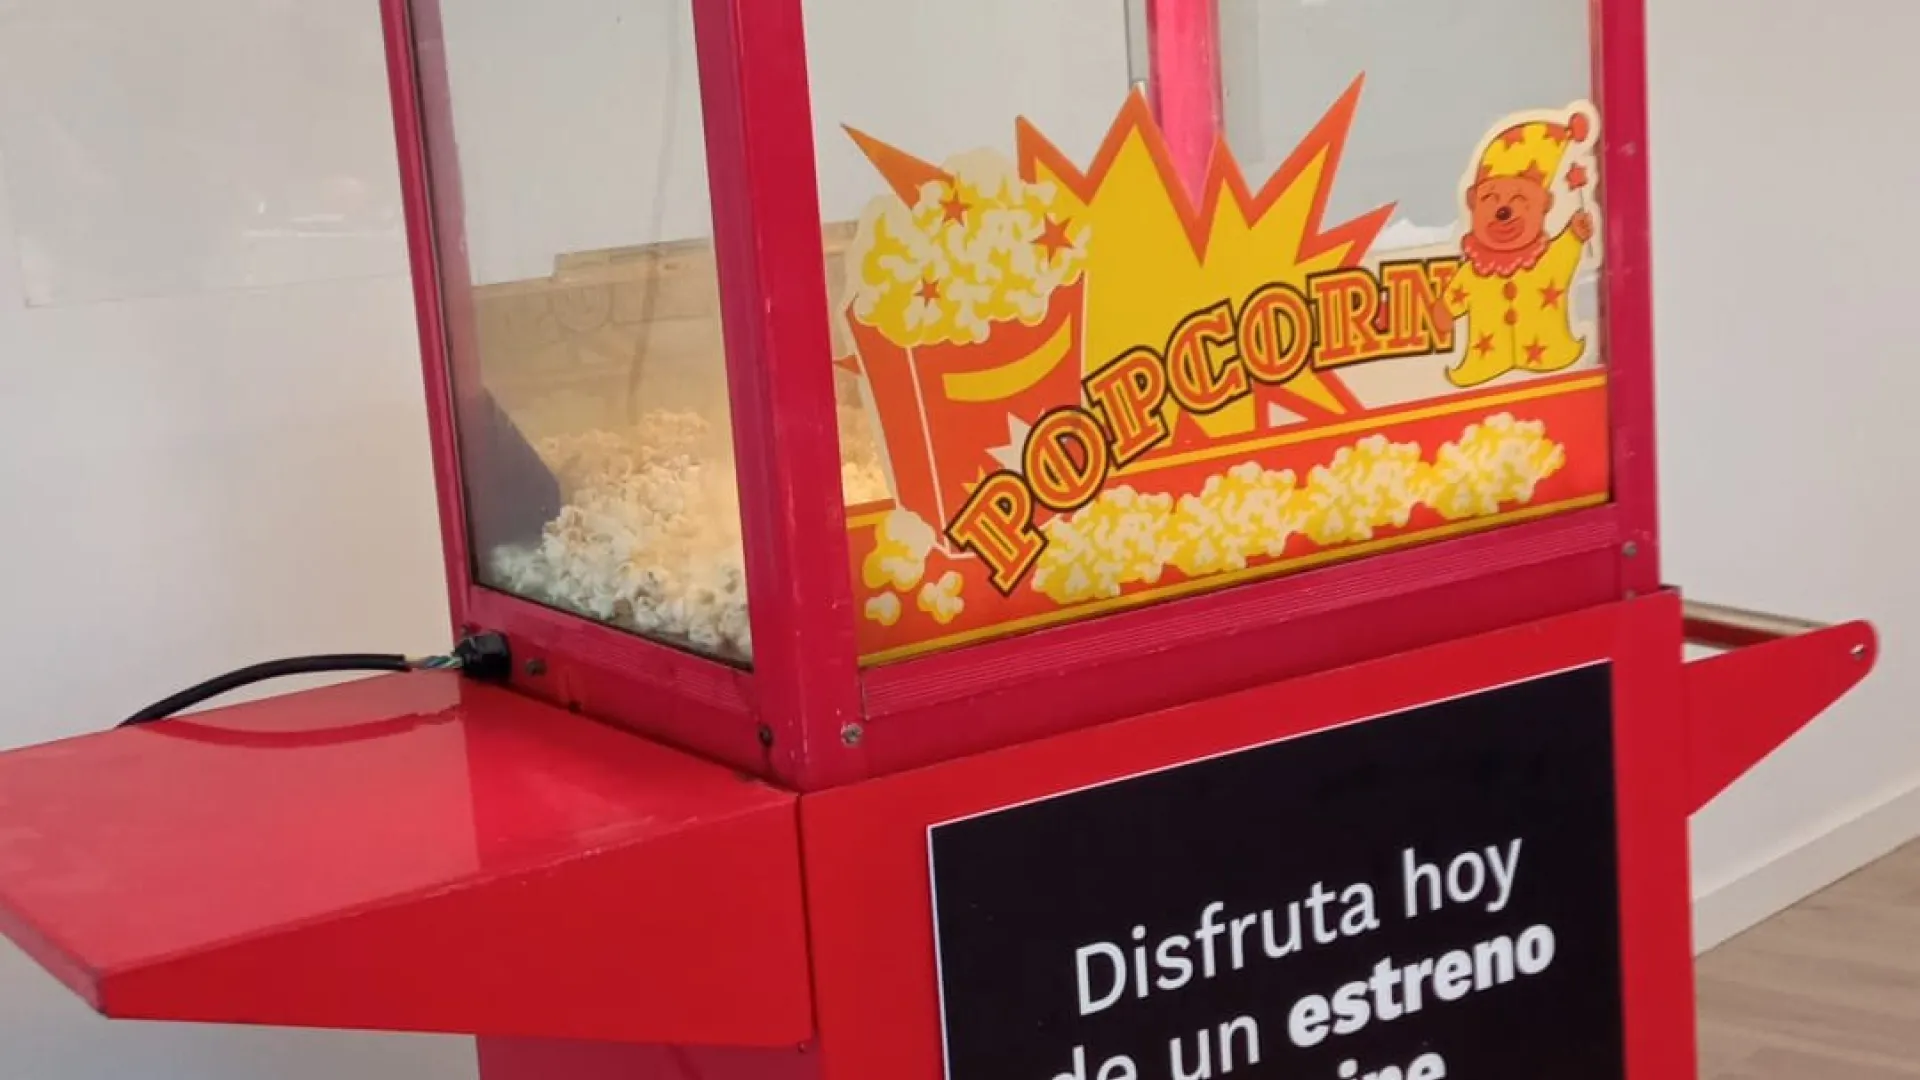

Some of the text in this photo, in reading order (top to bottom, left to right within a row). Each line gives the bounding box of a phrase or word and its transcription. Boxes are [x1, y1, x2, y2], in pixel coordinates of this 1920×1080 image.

[946, 256, 1461, 595] POPCORN
[1075, 838, 1523, 1016] Disfruta hoy
[1170, 1015, 1260, 1080] un
[1288, 924, 1555, 1048] estreno
